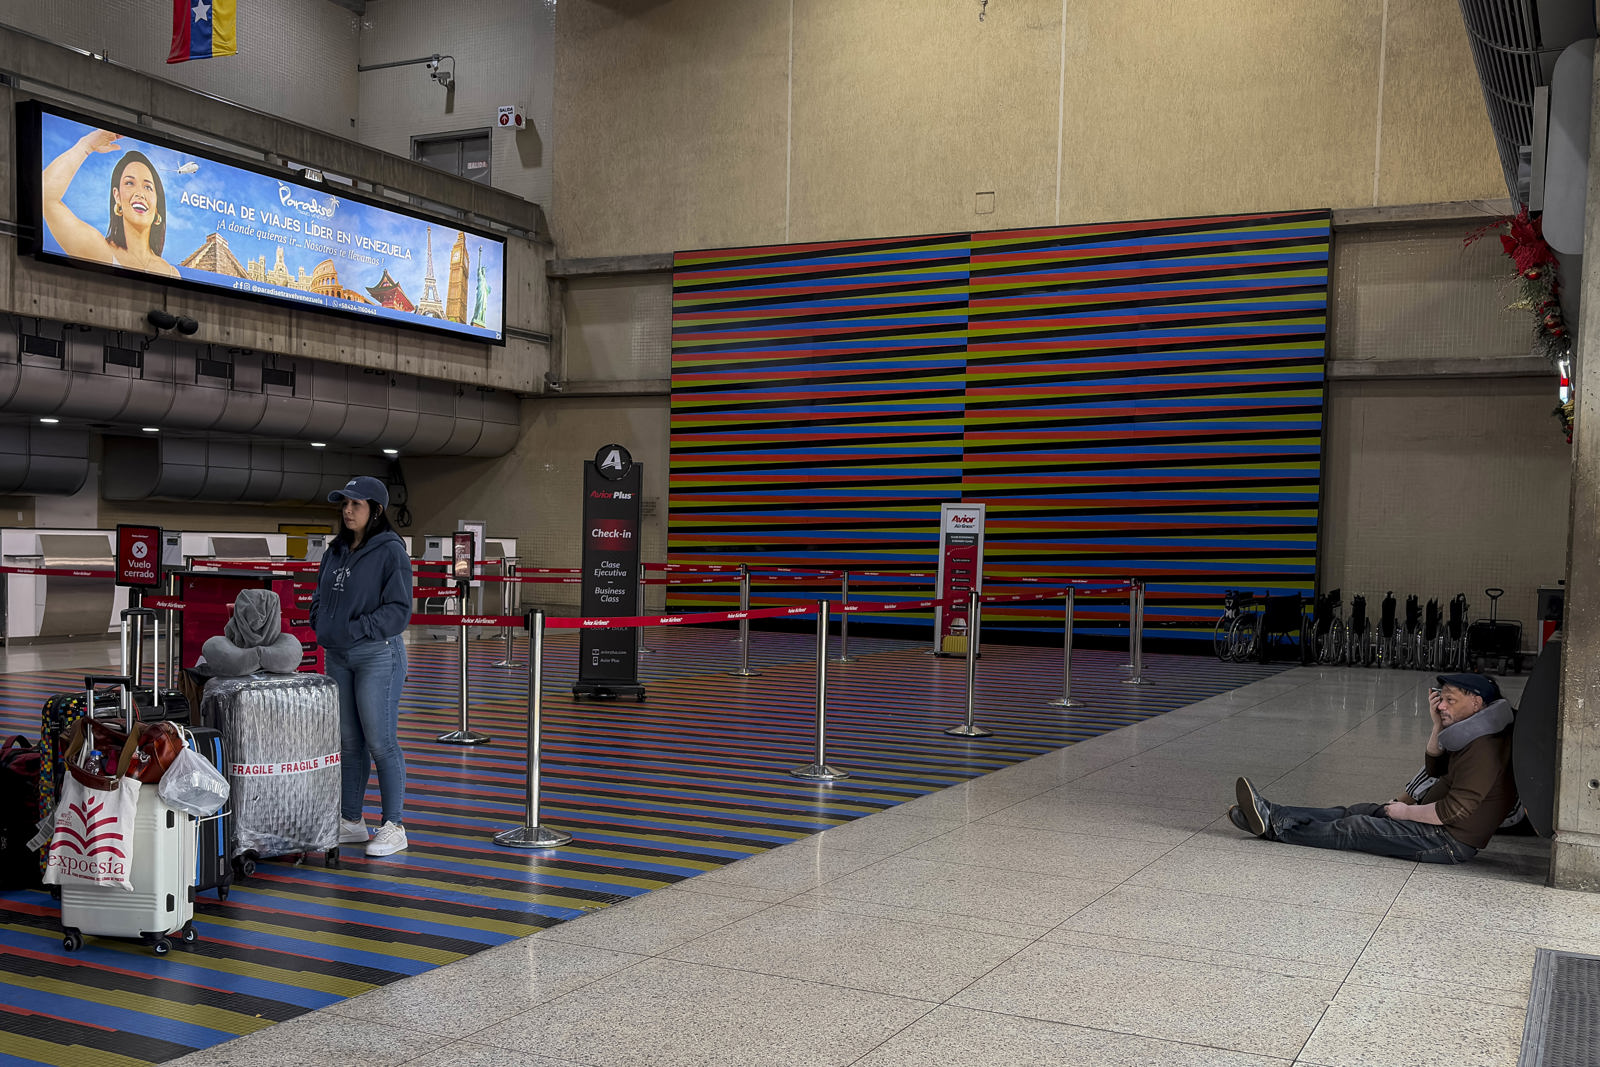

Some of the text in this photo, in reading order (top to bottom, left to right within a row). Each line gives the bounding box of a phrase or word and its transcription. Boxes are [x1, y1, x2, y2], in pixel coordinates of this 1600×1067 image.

[467, 161, 487, 169] SALIDA
[278, 182, 337, 218] Paradise
[181, 191, 236, 217] AGENCIA
[240, 205, 256, 221] DE
[260, 210, 301, 232] VIAJES
[304, 220, 333, 240] LÍDER
[337, 230, 351, 244] EN
[355, 235, 412, 260] VENEZUELA
[228, 221, 254, 236] donde
[257, 229, 287, 245] quieras
[304, 239, 337, 255] Nosotros
[340, 249, 346, 258] te
[348, 250, 379, 266] llevamos
[590, 490, 632, 499] Avior Plus
[952, 514, 976, 523] Avior
[591, 528, 632, 538] Check-in
[128, 559, 151, 569] Vuelo
[601, 561, 620, 569] Clase
[124, 570, 154, 578] cerrado
[594, 569, 627, 578] Ejecutiva
[595, 587, 626, 595] Business
[600, 595, 620, 603] Class
[232, 765, 274, 775] FRAGILE
[281, 759, 318, 773] FRAGILE
